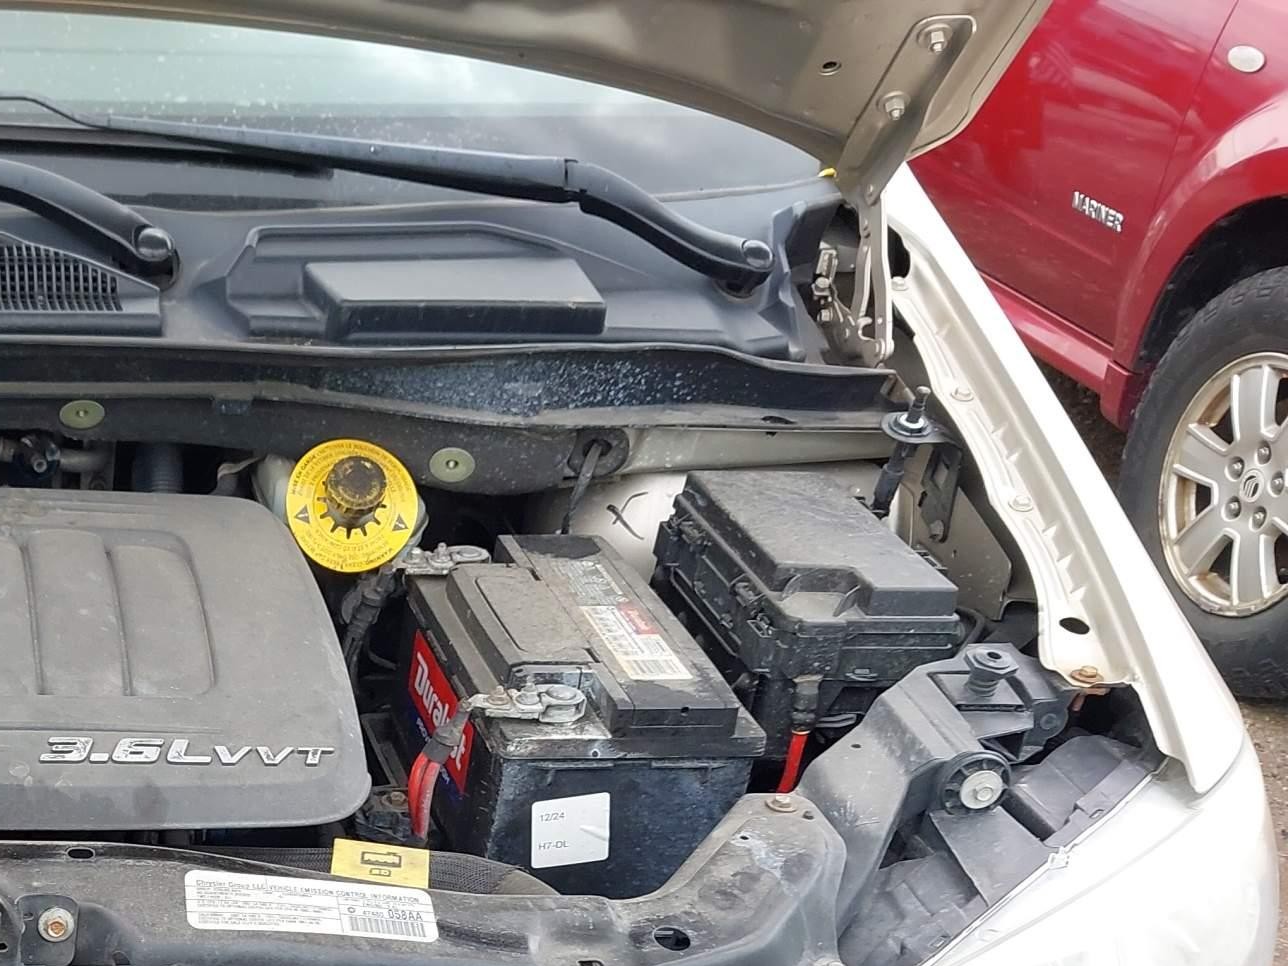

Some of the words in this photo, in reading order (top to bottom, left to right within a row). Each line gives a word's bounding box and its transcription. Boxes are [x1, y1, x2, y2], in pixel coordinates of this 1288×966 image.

[1072, 191, 1124, 233] MARINER
[414, 651, 466, 771] Duralst
[540, 811, 565, 822] 12/24
[300, 887, 334, 896] EMISSION
[336, 890, 366, 898] CONTROL
[370, 893, 420, 903] INFORMATION
